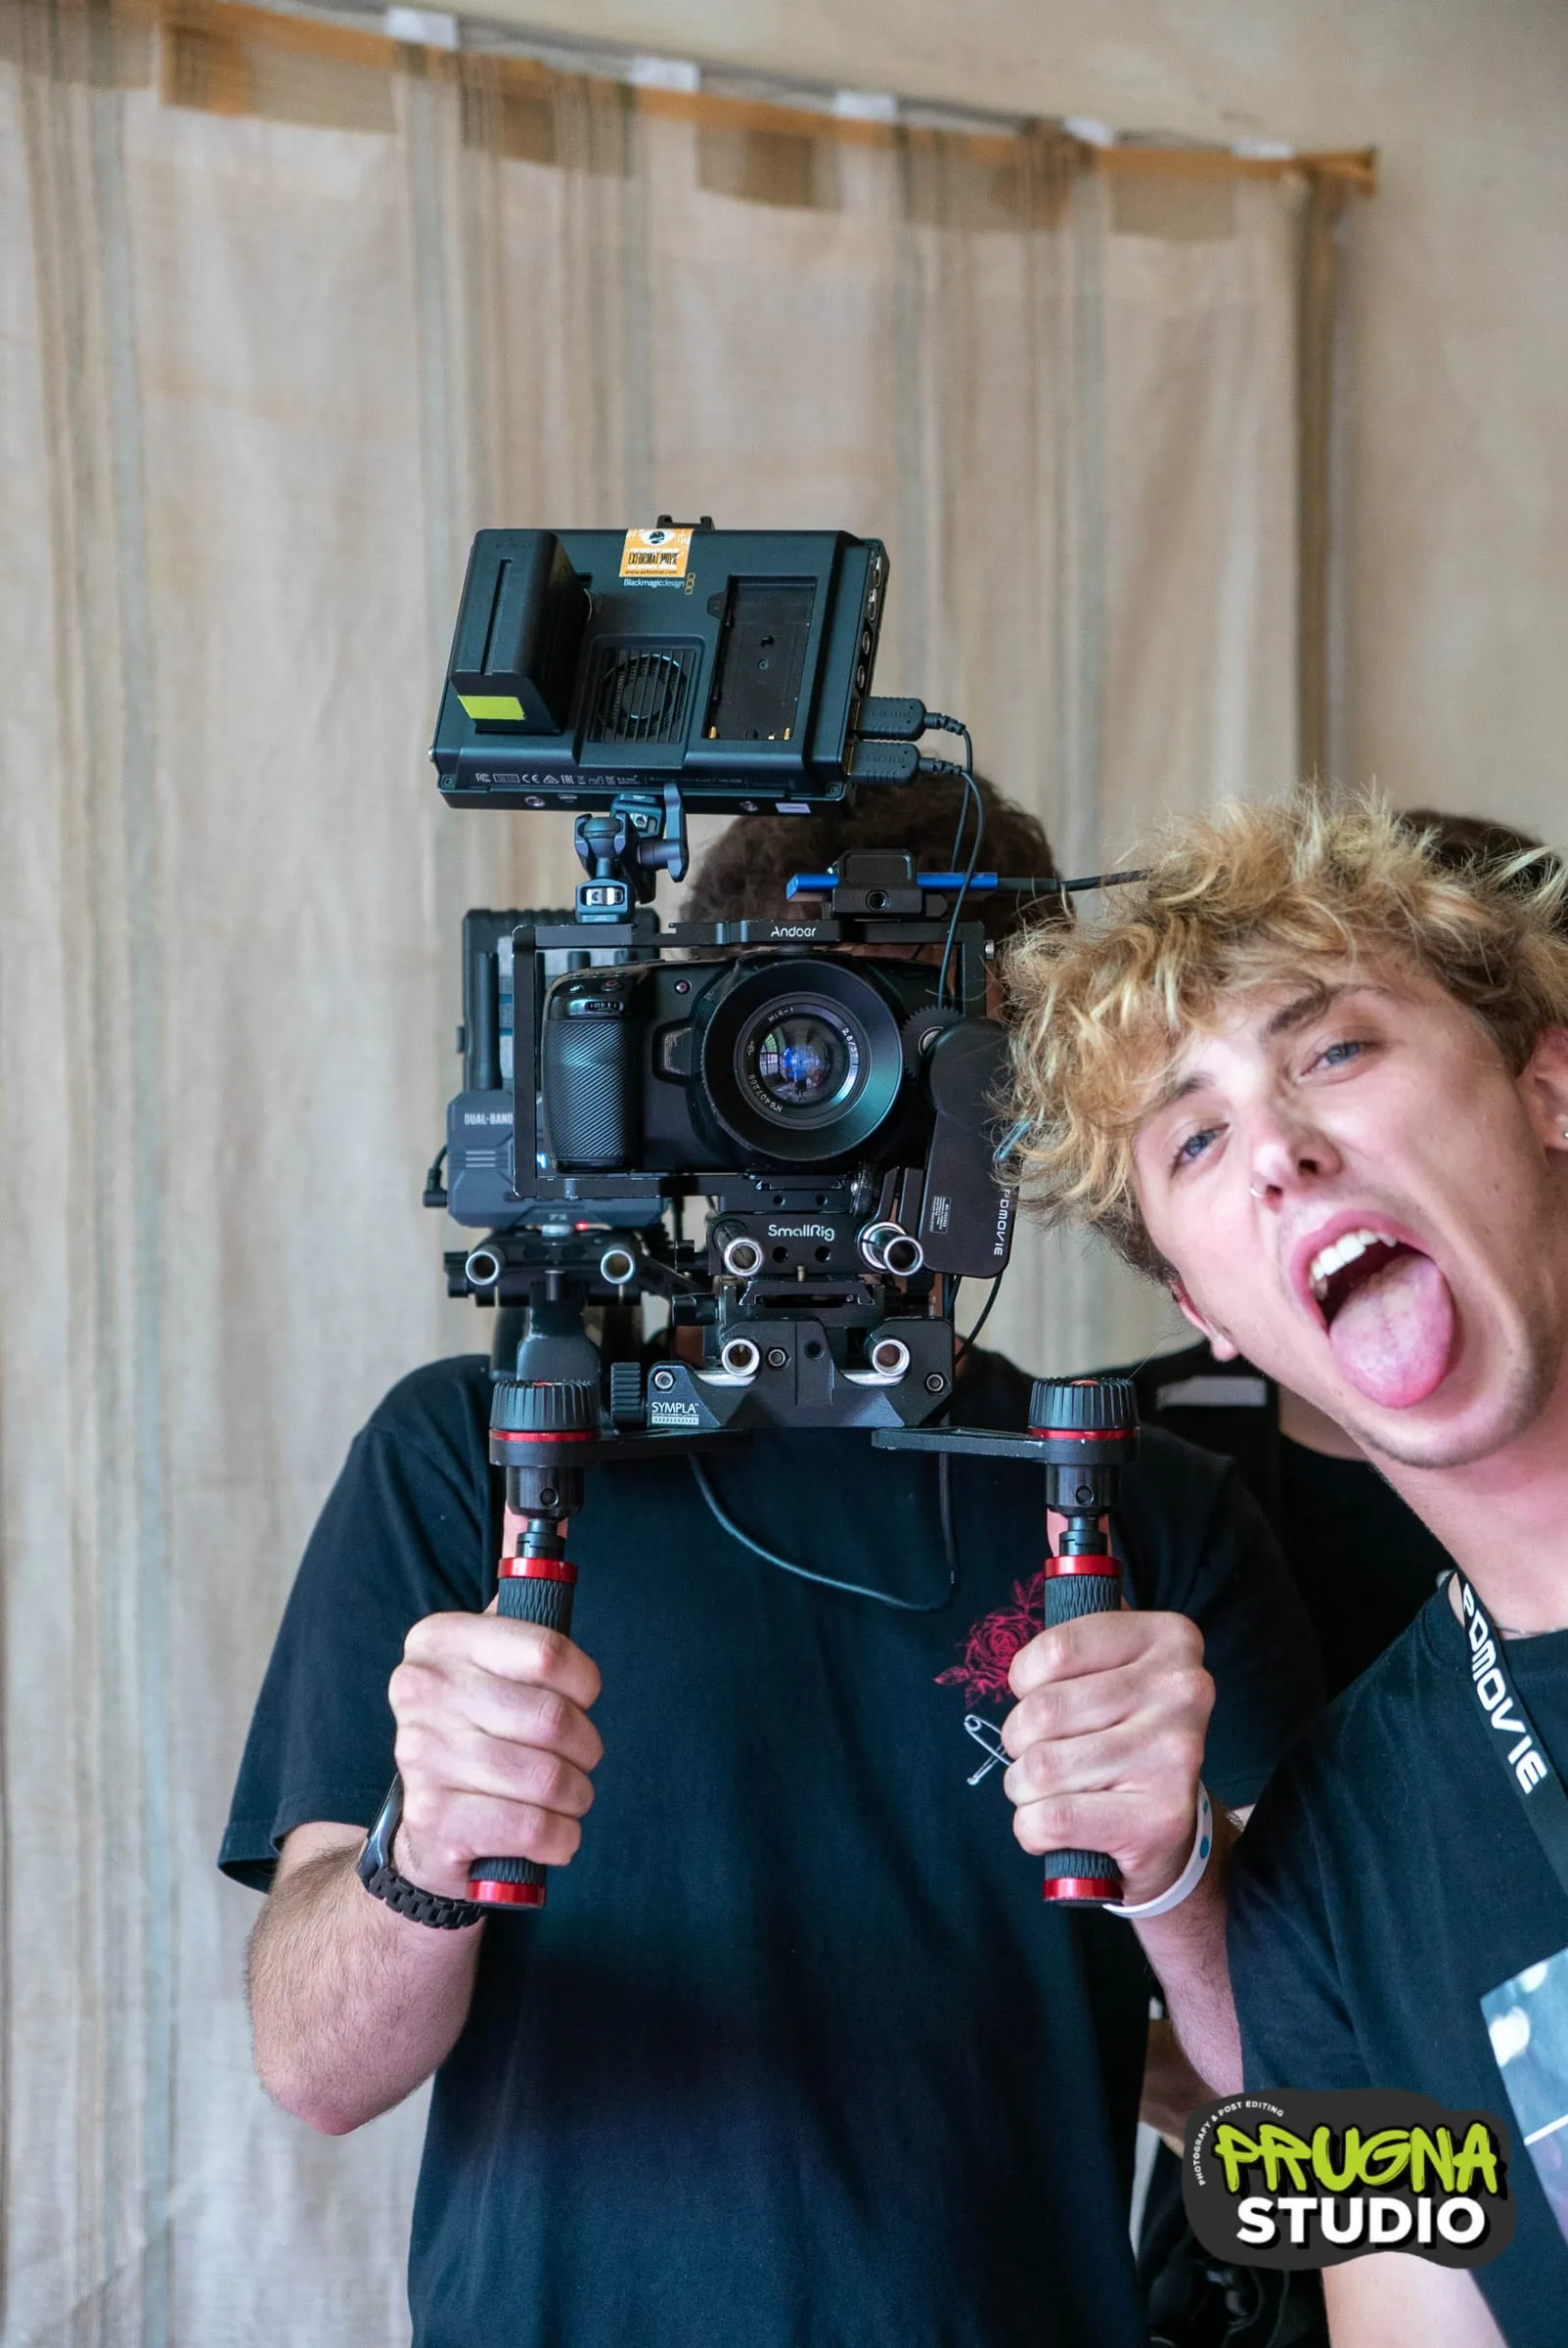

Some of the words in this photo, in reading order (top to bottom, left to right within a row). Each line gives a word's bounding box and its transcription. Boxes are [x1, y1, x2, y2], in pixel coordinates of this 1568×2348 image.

[771, 926, 817, 937] Andoer
[464, 1112, 514, 1125] DUAL-BAND
[768, 1224, 835, 1242] SmallRig
[1462, 1582, 1547, 1794] PDMOVIE
